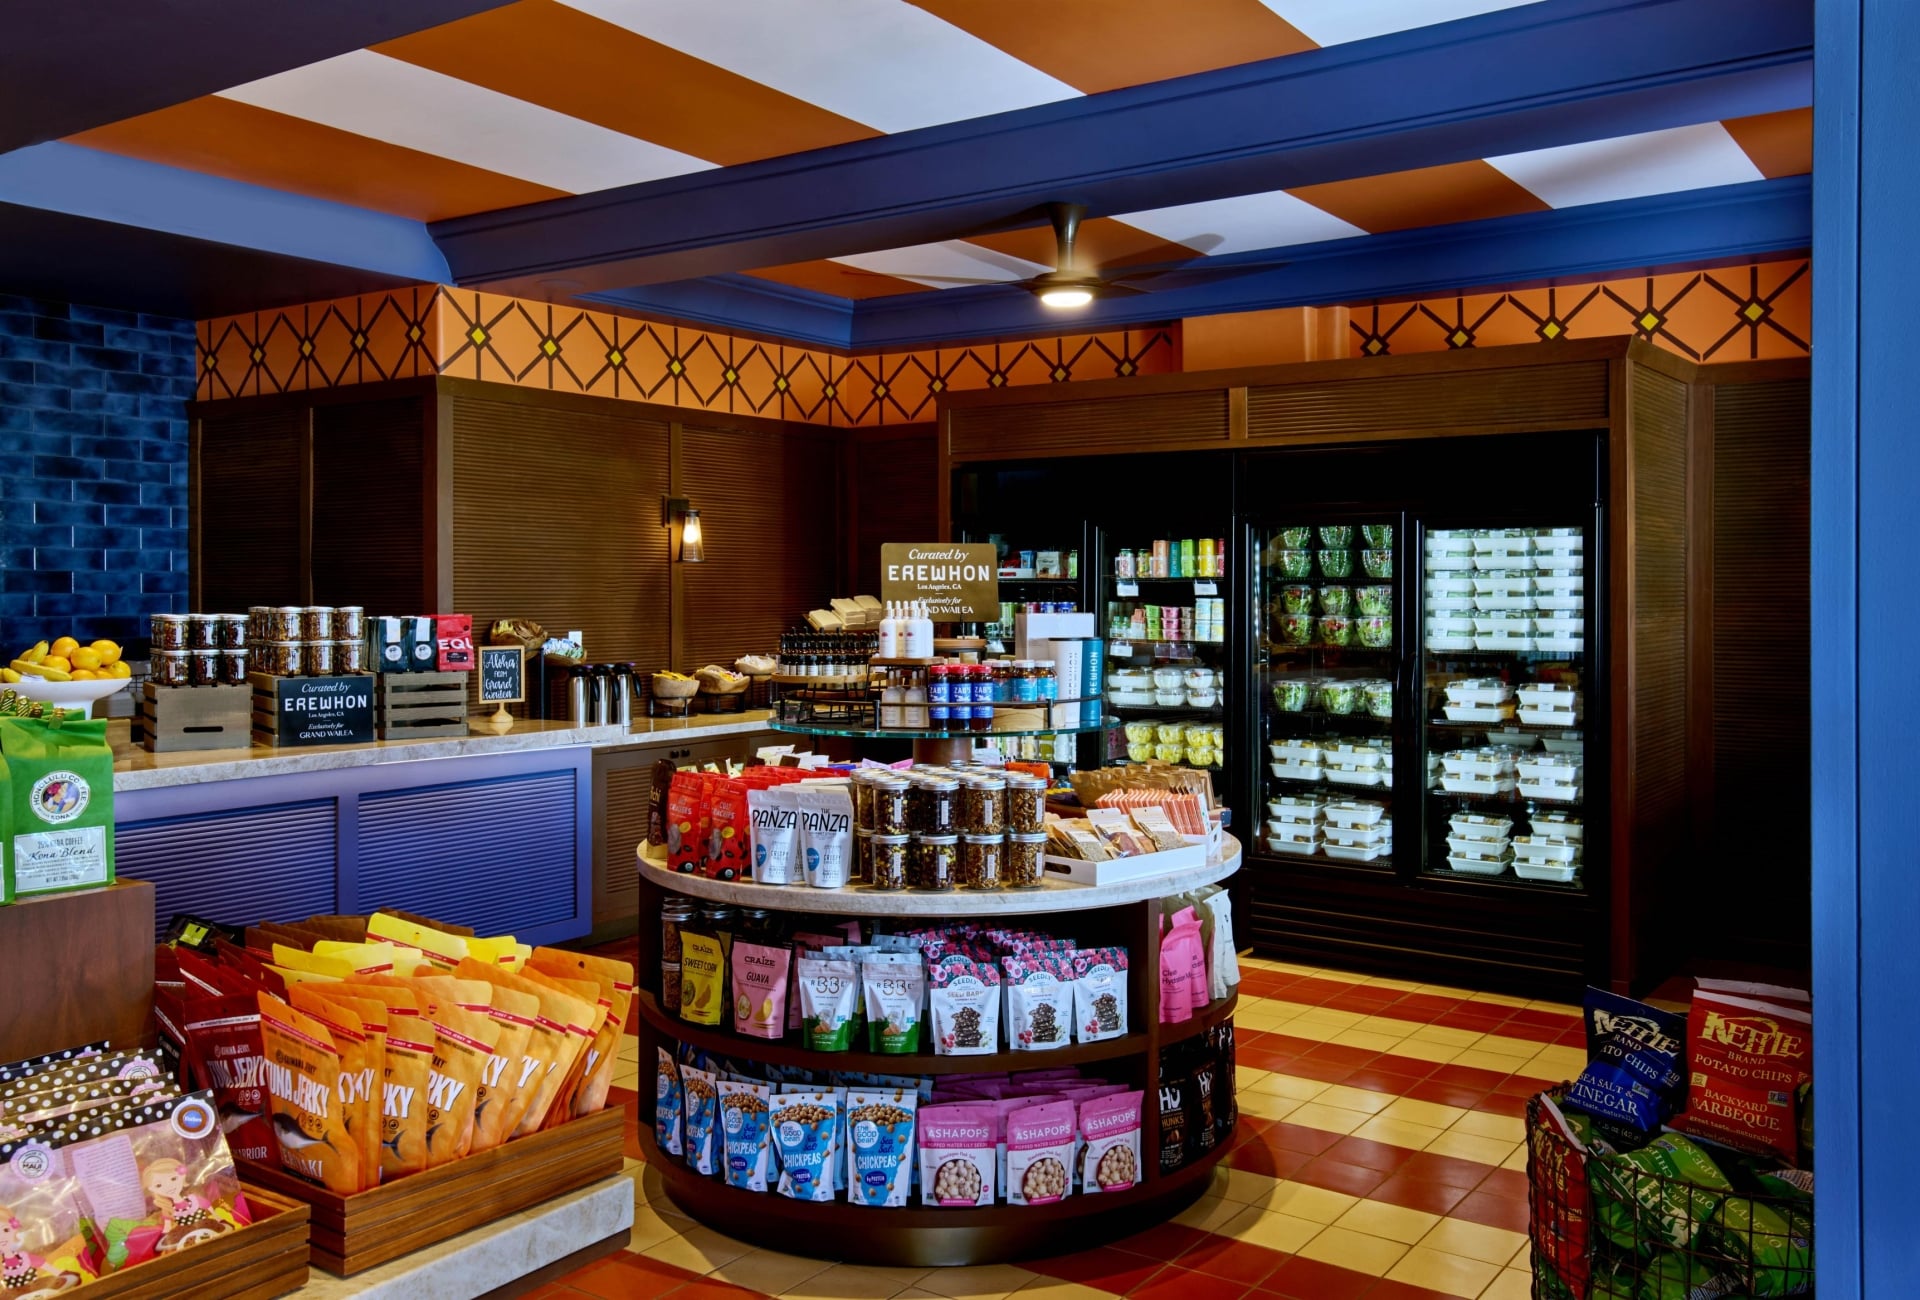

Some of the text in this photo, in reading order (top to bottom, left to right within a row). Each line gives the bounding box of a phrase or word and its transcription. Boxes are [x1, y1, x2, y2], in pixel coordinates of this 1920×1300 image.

[908, 548, 970, 563] Curated by
[888, 565, 990, 581] EREWHON
[951, 597, 963, 605] for
[941, 606, 974, 614] WAILEA
[485, 653, 515, 669] Aloha
[1089, 651, 1099, 695] REWHON
[301, 682, 351, 694] Curated by
[485, 676, 512, 690] Grand
[284, 695, 367, 711] EREWHON
[299, 729, 353, 739] GRAND WAILEA
[752, 809, 798, 830] PANZA
[802, 812, 849, 832] PANZA
[60, 843, 96, 857] Blend
[683, 957, 704, 969] SWEET
[746, 971, 770, 984] GUAVA
[1613, 1034, 1643, 1051] RAND
[1696, 1009, 1806, 1060] KETTLE
[1601, 1043, 1660, 1080] ATO CHIPS
[1727, 1051, 1767, 1065] BRAND
[234, 1055, 266, 1089] JERKY
[1665, 1068, 1680, 1083] 210
[1694, 1053, 1749, 1078] POTATO
[1751, 1068, 1793, 1084] CHIPS
[265, 1058, 293, 1102] TUNA
[292, 1072, 330, 1118] JERKY
[1597, 1078, 1624, 1095] SALT
[1625, 1090, 1635, 1099] &
[1570, 1082, 1640, 1117] VINEGAR
[1704, 1088, 1768, 1113] BACKYARD
[1087, 1110, 1137, 1132] ASHAPOPS
[928, 1128, 989, 1139] ASHAPOPS
[1016, 1124, 1071, 1141] ASHAPOPS
[727, 1141, 757, 1154] HICKPEAS
[783, 1152, 821, 1168] CHICKPEAS
[857, 1155, 897, 1169] CHICKPEAS
[1676, 1183, 1715, 1210] OTATO
